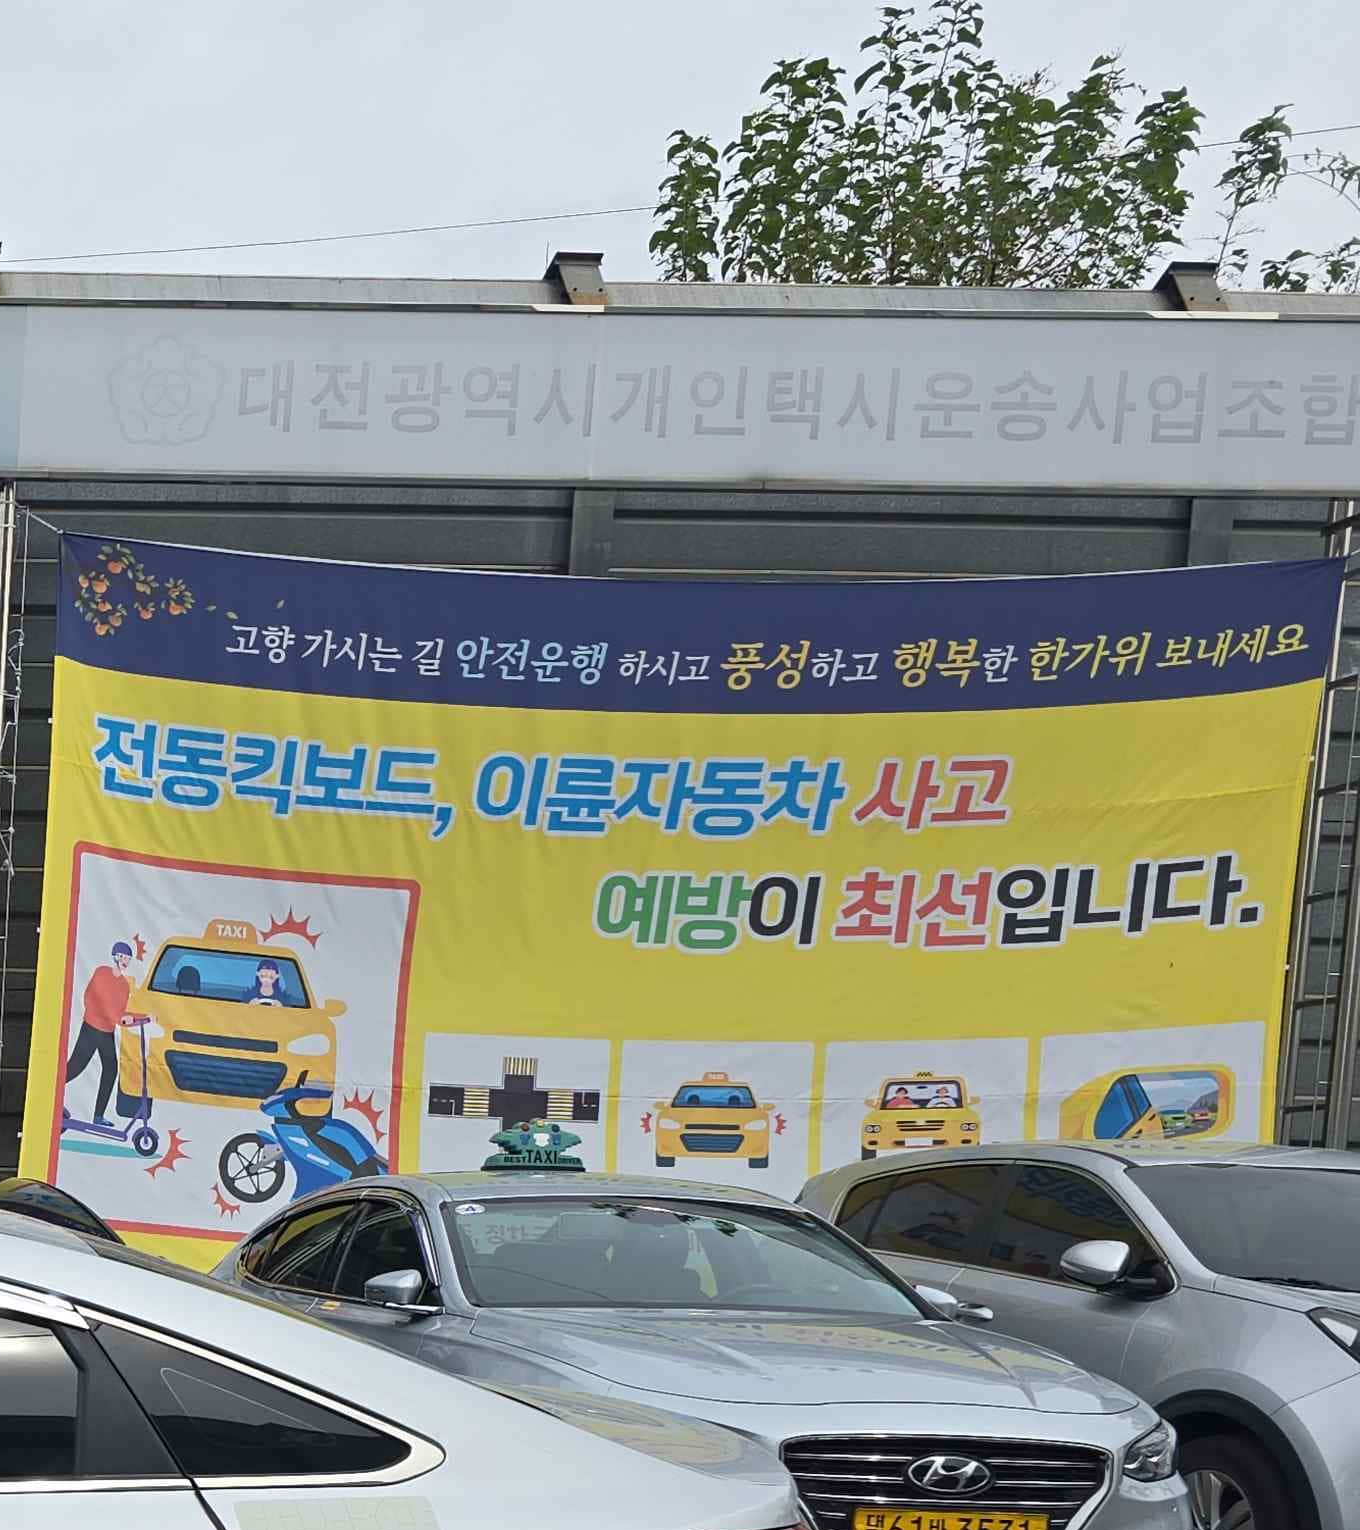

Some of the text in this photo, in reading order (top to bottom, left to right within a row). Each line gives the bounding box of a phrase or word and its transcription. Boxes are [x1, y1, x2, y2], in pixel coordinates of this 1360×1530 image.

[238, 359, 1360, 447] 대전광역시개인택시운송사업조합
[226, 623, 1310, 690] 고향 가시는 길 안전운행 하시고 풍성하고 행복한 한가위 보내세요
[93, 715, 1010, 839] 전동킥보드, 이륜자동차 사고
[215, 924, 247, 939] TAXI
[596, 856, 1260, 950] 예방이 최선입니다.
[527, 1150, 557, 1164] TAXI
